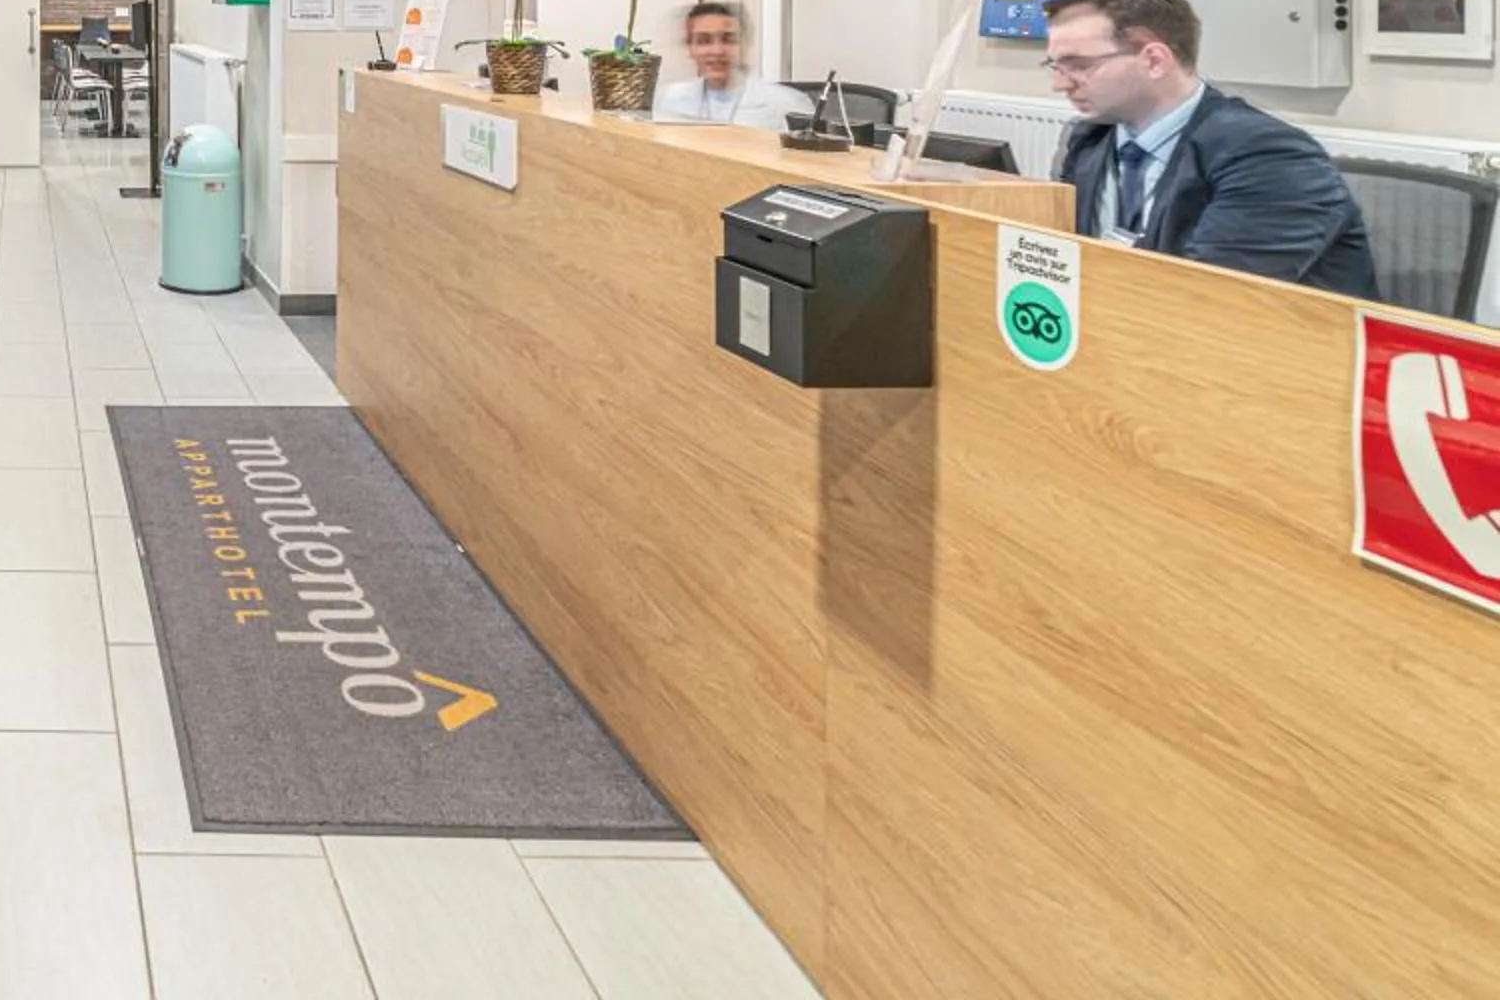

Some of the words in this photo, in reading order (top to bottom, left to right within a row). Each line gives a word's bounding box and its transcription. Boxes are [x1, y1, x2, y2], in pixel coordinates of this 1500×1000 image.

[1018, 235, 1059, 257] Écrivez
[172, 438, 272, 626] APPARTHOTEL
[226, 435, 426, 717] montempo
